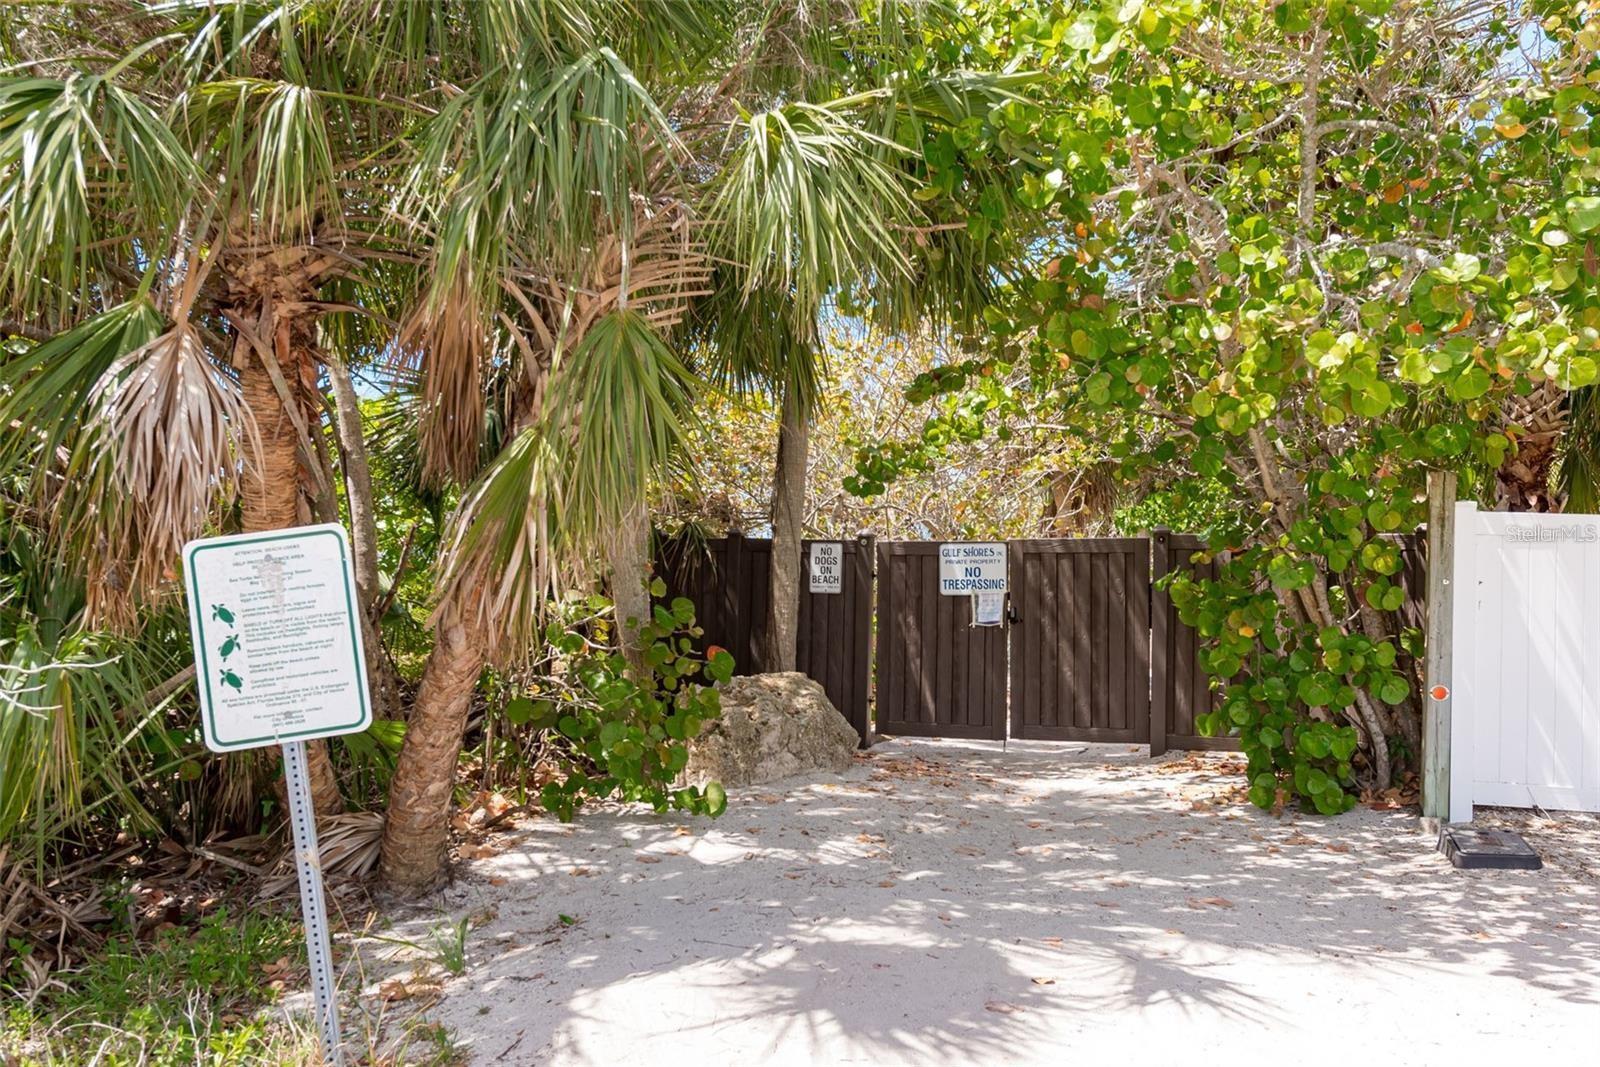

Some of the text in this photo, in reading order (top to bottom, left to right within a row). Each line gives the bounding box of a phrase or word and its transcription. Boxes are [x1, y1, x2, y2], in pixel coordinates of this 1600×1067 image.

[820, 547, 833, 556] NO
[942, 549, 961, 557] GULF
[963, 547, 995, 557] SHORES
[815, 556, 838, 566] DOGS
[820, 566, 832, 575] ON
[965, 567, 981, 578] NO
[812, 575, 839, 584] BEACH
[943, 579, 1005, 590] TRESPASSING
